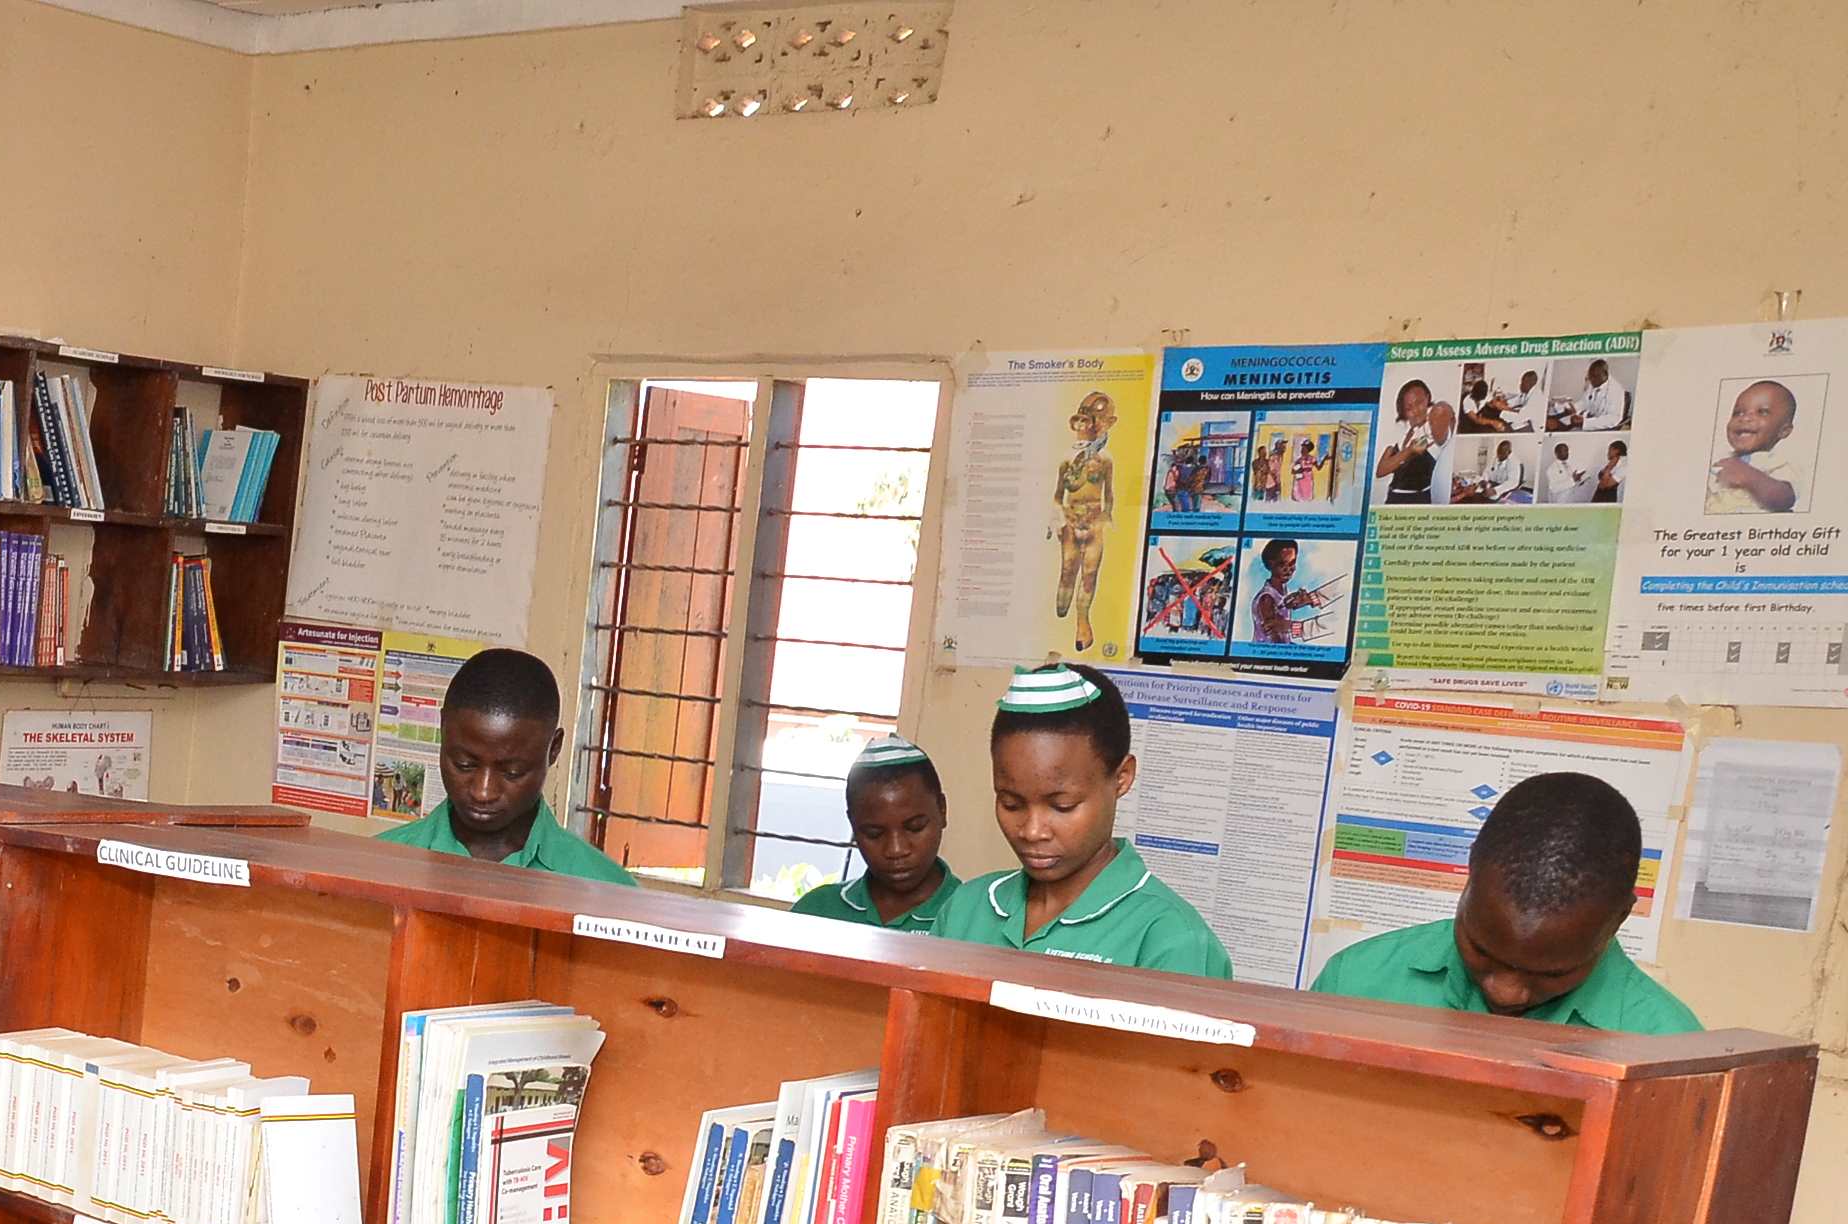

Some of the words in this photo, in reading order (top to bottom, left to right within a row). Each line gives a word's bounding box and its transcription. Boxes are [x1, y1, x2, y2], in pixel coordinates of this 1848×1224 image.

[1390, 346, 1420, 359] Steps
[1422, 345, 1433, 357] to
[1435, 344, 1471, 357] Assess
[1474, 342, 1518, 356] Adverse
[1521, 339, 1549, 355] Drug
[1552, 338, 1602, 352] Reaction
[1605, 335, 1639, 352] (ADR)
[1008, 360, 1025, 370] The
[1029, 359, 1074, 370] Smoker's
[1078, 359, 1104, 370] Body
[1230, 356, 1337, 368] MENINGOCOCCAL
[1224, 371, 1331, 386] MENINGITIS
[365, 379, 392, 402] Post
[395, 382, 436, 407] Partum
[438, 384, 504, 416] Hemorrhage
[1201, 392, 1219, 401] How
[1221, 392, 1235, 400] can
[1237, 391, 1275, 400] Meningitis
[1277, 391, 1287, 399] be
[1289, 391, 1335, 401] prevented?
[1654, 530, 1678, 541] The
[1683, 529, 1742, 541] Greatest
[1748, 527, 1806, 542] Birthday
[1812, 527, 1841, 540] Gift
[1660, 547, 1680, 558] for
[1687, 548, 1715, 560] your
[1721, 546, 1727, 557] 1
[1735, 547, 1762, 560] year
[1770, 545, 1790, 556] old
[1796, 544, 1829, 556] child
[1735, 562, 1746, 573] is
[1642, 581, 1695, 592] Completing
[1697, 581, 1712, 591] the
[1715, 581, 1749, 591] Child's
[1752, 581, 1819, 591] Immunisation
[1657, 603, 1675, 612] five
[1679, 603, 1703, 612] times
[1708, 603, 1739, 612] before
[1744, 603, 1766, 612] first
[1770, 603, 1815, 613] Birthday.
[297, 627, 335, 641] Artesunate
[337, 631, 347, 641] for
[349, 632, 379, 644] Injection
[1481, 679, 1501, 687] SAVE
[1151, 679, 1164, 689] for
[1167, 681, 1201, 695] Priority
[1203, 685, 1241, 698] diseases
[1243, 688, 1261, 699] and
[1263, 690, 1296, 702] events
[1298, 694, 1312, 703] for
[1137, 692, 1171, 702] Disease
[1173, 696, 1227, 709] Surveillance
[1230, 698, 1248, 710] and
[1251, 700, 1296, 714] Response
[1394, 701, 1431, 712] COVID-19
[24, 733, 43, 743] THE
[46, 732, 95, 743] SKELETAL
[97, 732, 134, 743] SYSTEM
[99, 844, 162, 868] CLINICAL
[165, 855, 243, 880] GUIDELINE
[841, 1135, 857, 1174] Primary
[837, 1179, 852, 1214] Mother
